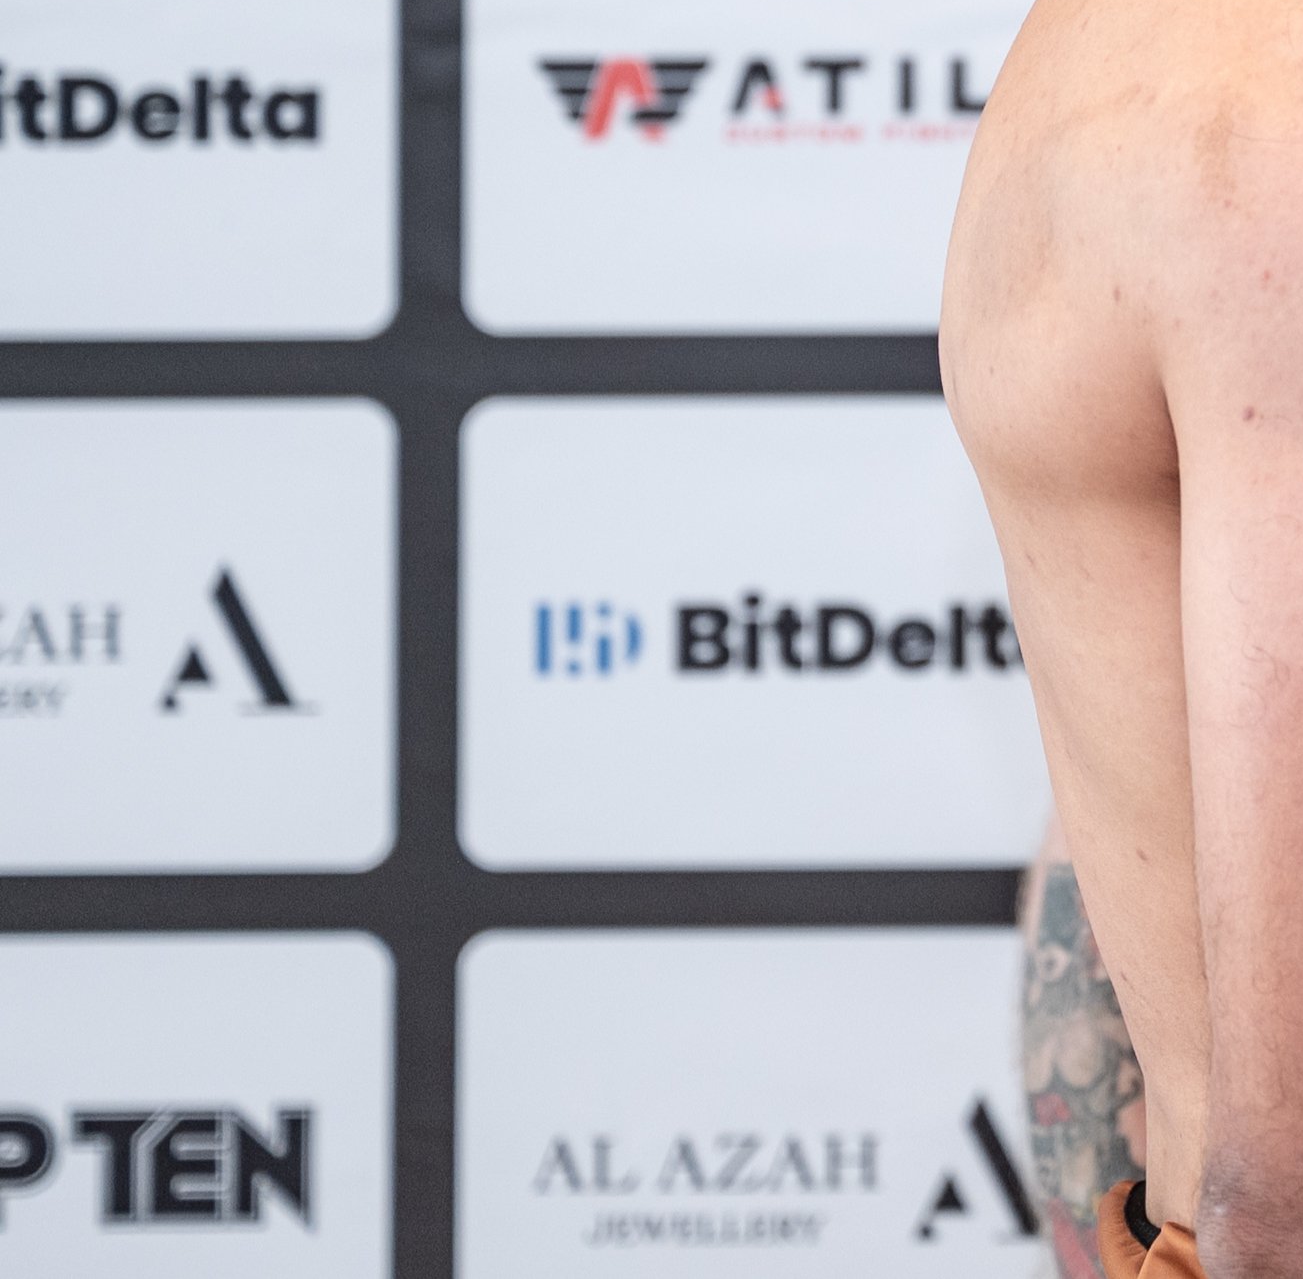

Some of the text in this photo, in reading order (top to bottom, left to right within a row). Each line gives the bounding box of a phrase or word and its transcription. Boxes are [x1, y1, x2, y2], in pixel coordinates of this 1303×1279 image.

[0, 603, 122, 663] AH
[674, 585, 1027, 678] BitDelt
[66, 1106, 319, 1230] TEN
[655, 1132, 880, 1195] AZAH
